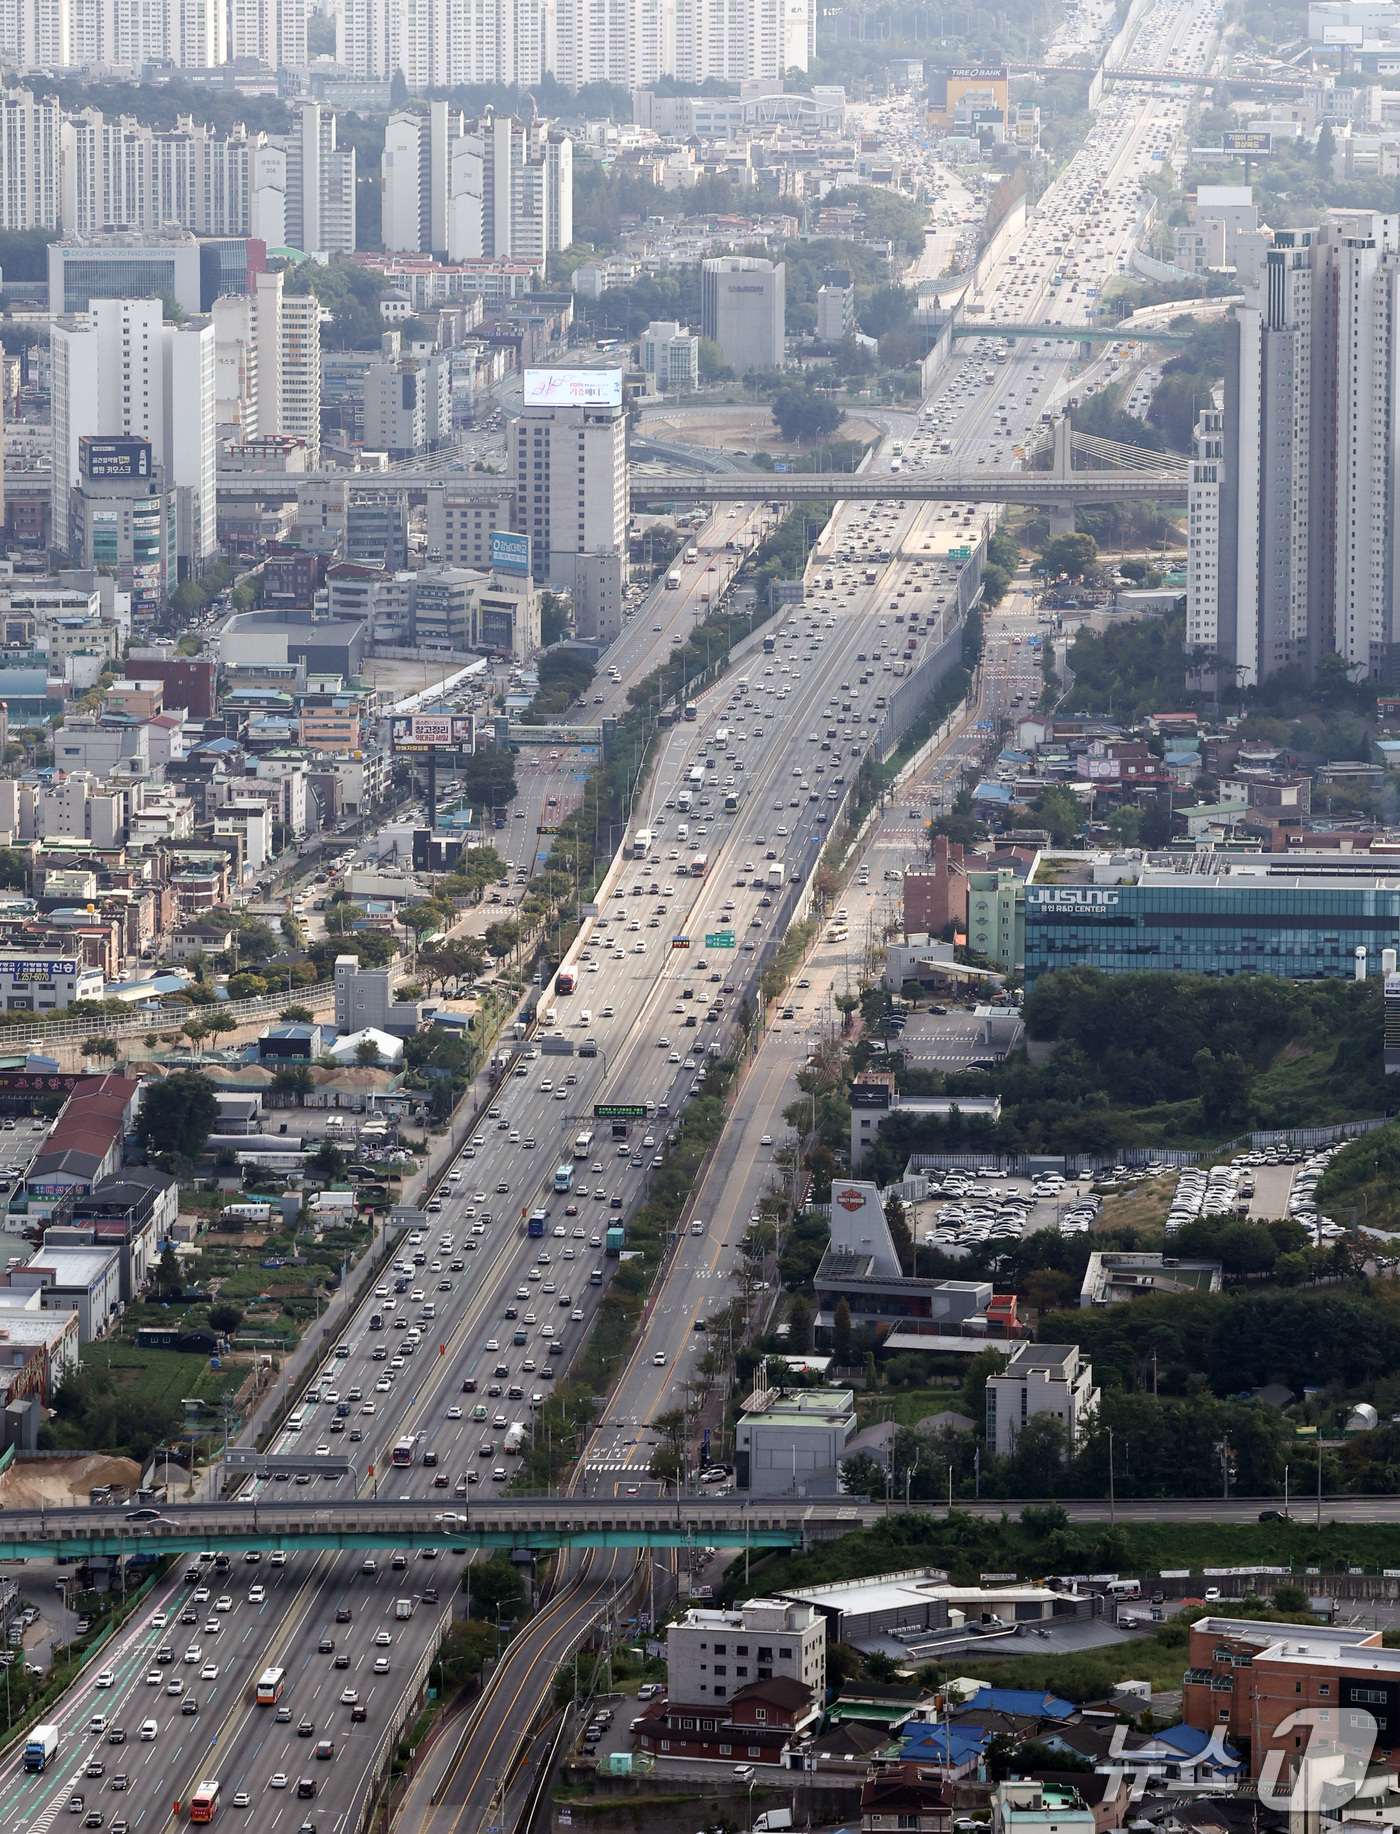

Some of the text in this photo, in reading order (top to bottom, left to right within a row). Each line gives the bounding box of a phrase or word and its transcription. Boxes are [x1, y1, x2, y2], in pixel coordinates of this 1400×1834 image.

[106, 466, 131, 474] 키오스크
[500, 541, 527, 554] 강남대학교
[415, 726, 449, 734] 창고정리
[1028, 890, 1118, 904] JUSUNG
[52, 963, 74, 973] 신승
[15, 973, 49, 981] T.257-6070
